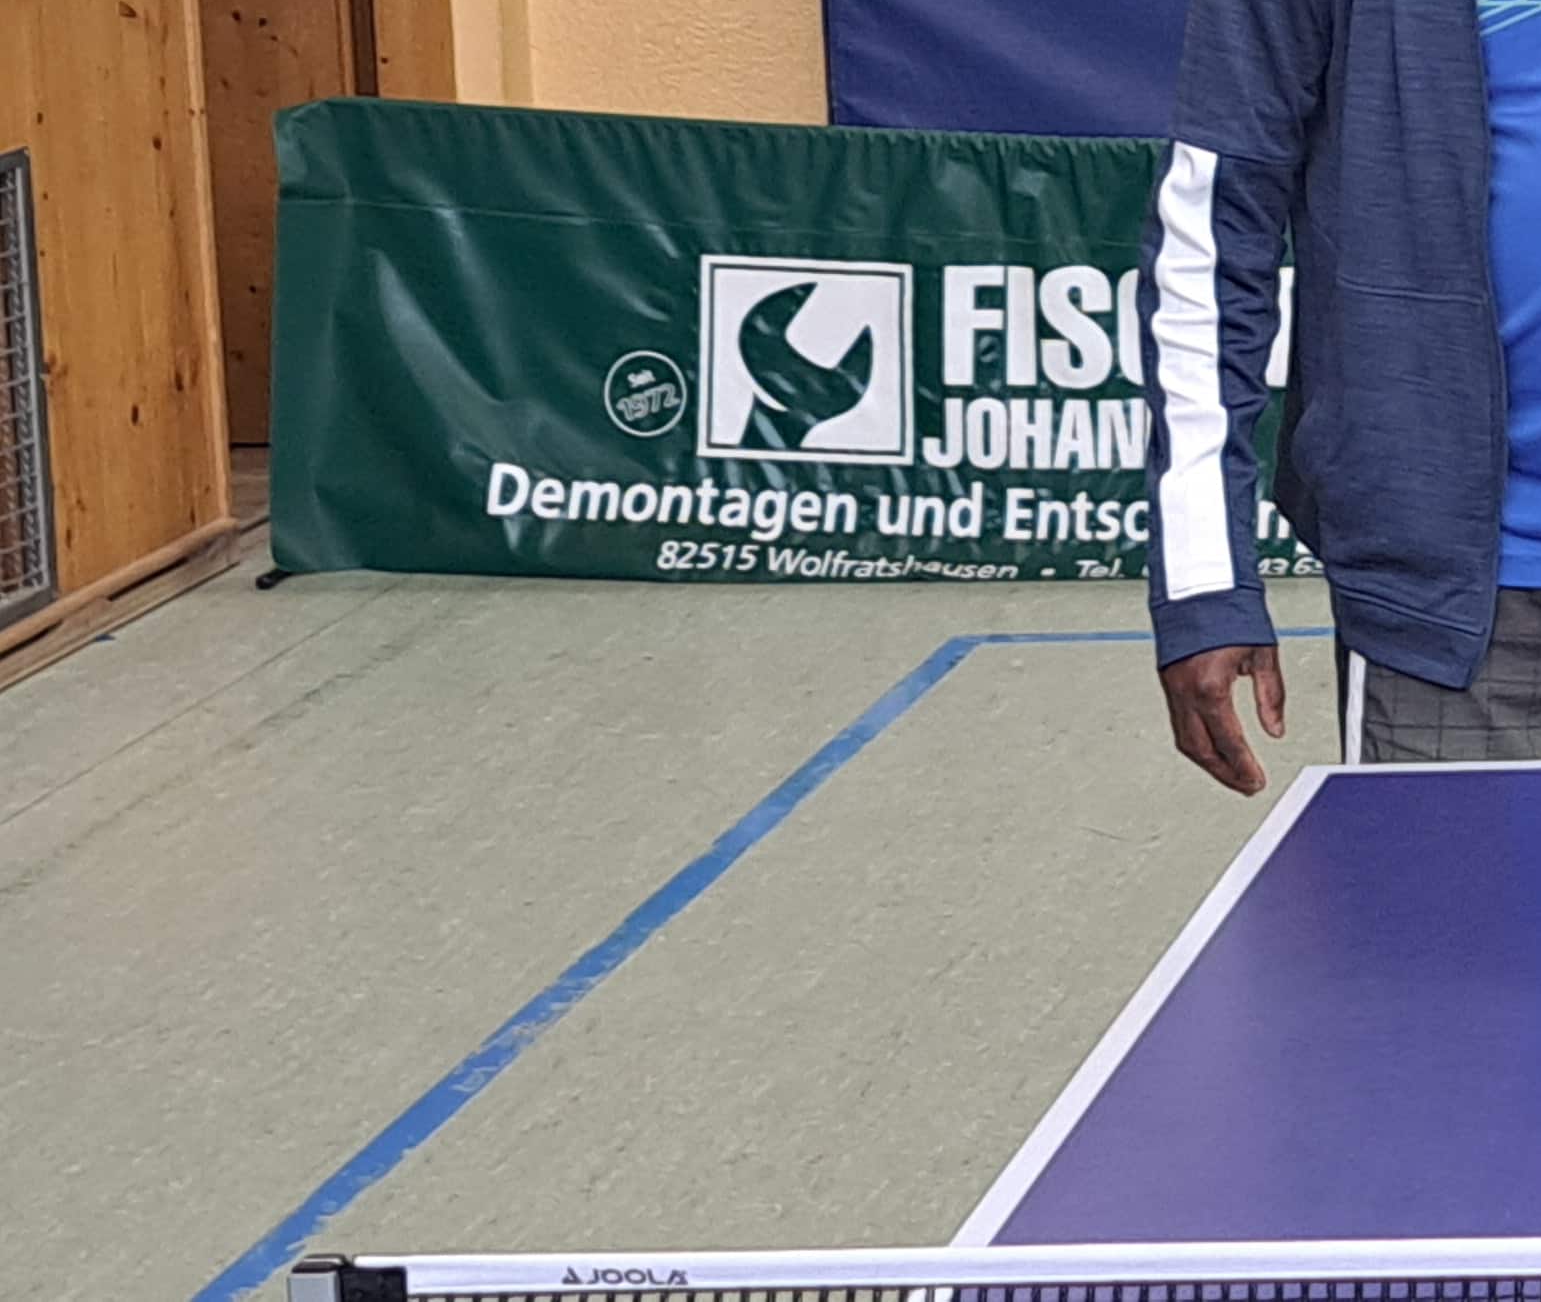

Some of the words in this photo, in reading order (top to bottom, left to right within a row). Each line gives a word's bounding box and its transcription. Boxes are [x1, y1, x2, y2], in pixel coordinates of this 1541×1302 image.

[616, 382, 681, 422] 1972
[922, 396, 1152, 470] JOHAN
[486, 462, 858, 541] Demontagen
[877, 481, 983, 537] und
[657, 540, 760, 571] 82515
[767, 546, 1019, 579] Wolfratshausen
[1075, 557, 1125, 579] Tel.
[585, 1266, 689, 1286] JOOLA
